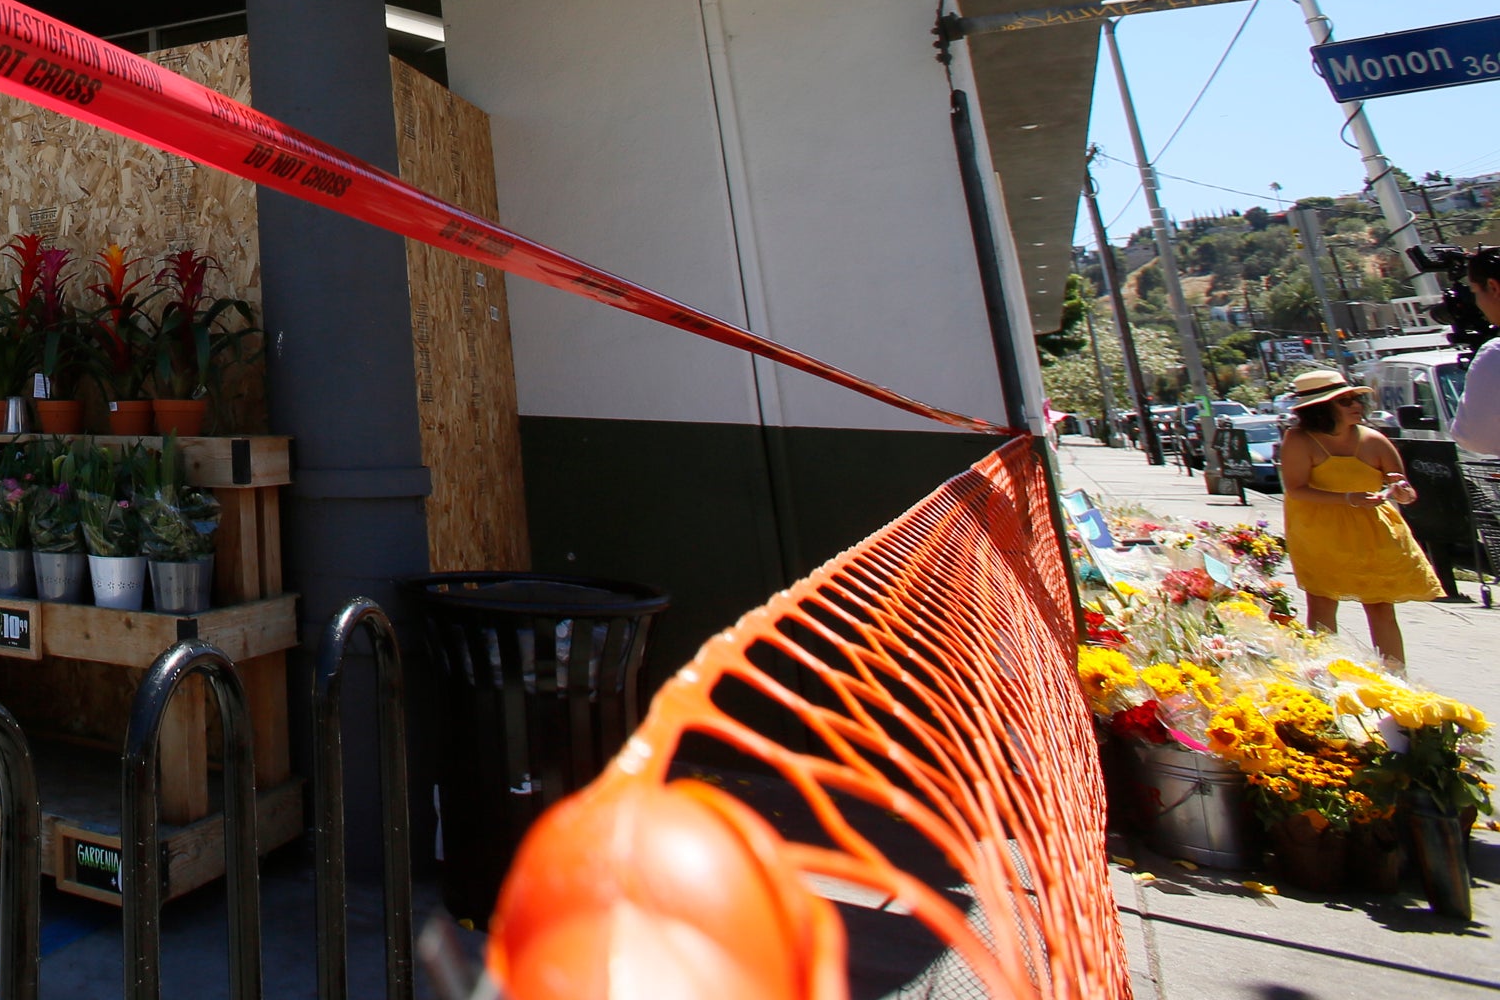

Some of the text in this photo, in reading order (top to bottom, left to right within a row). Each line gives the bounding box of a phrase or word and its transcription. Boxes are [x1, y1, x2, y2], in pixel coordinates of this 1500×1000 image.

[22, 56, 102, 106] CROSS
[106, 45, 164, 95] DIVISION
[1328, 46, 1453, 86] Monon
[243, 142, 271, 169] DO
[267, 152, 306, 181] NOT
[299, 164, 354, 199] CROSS
[77, 843, 119, 872] GARDENIA
